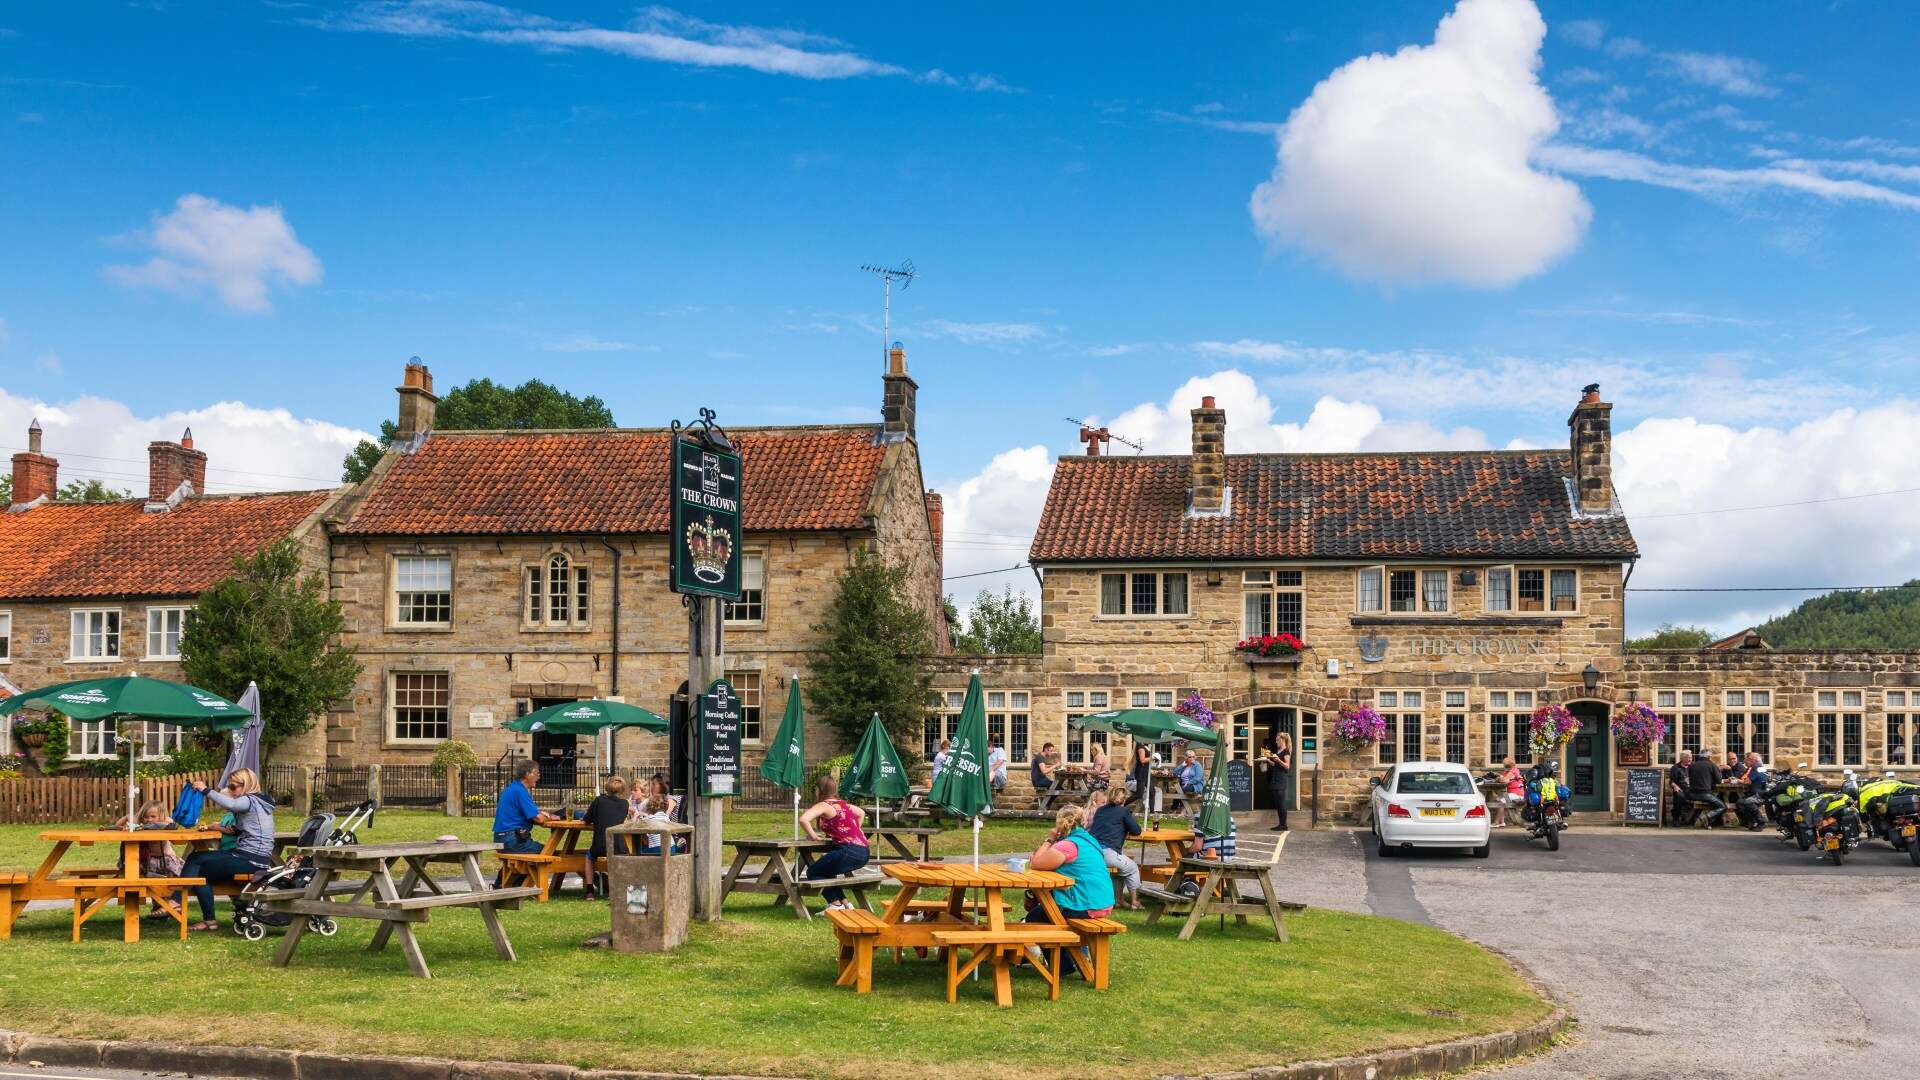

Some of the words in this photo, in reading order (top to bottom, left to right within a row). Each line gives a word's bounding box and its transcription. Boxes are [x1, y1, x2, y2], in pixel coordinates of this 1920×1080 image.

[681, 487, 702, 504] THE
[703, 493, 737, 512] CROWN
[1408, 637, 1449, 657] THE
[1455, 637, 1543, 657] CROWN
[704, 710, 724, 720] Morning
[724, 711, 738, 719] Coffee
[720, 723, 737, 731] Cooked
[716, 731, 728, 739] Food
[713, 743, 730, 751] Snacks
[709, 755, 734, 763] Traditional
[705, 763, 722, 772] Sunday
[723, 763, 737, 771] Lunch
[1439, 808, 1452, 816] LYK
